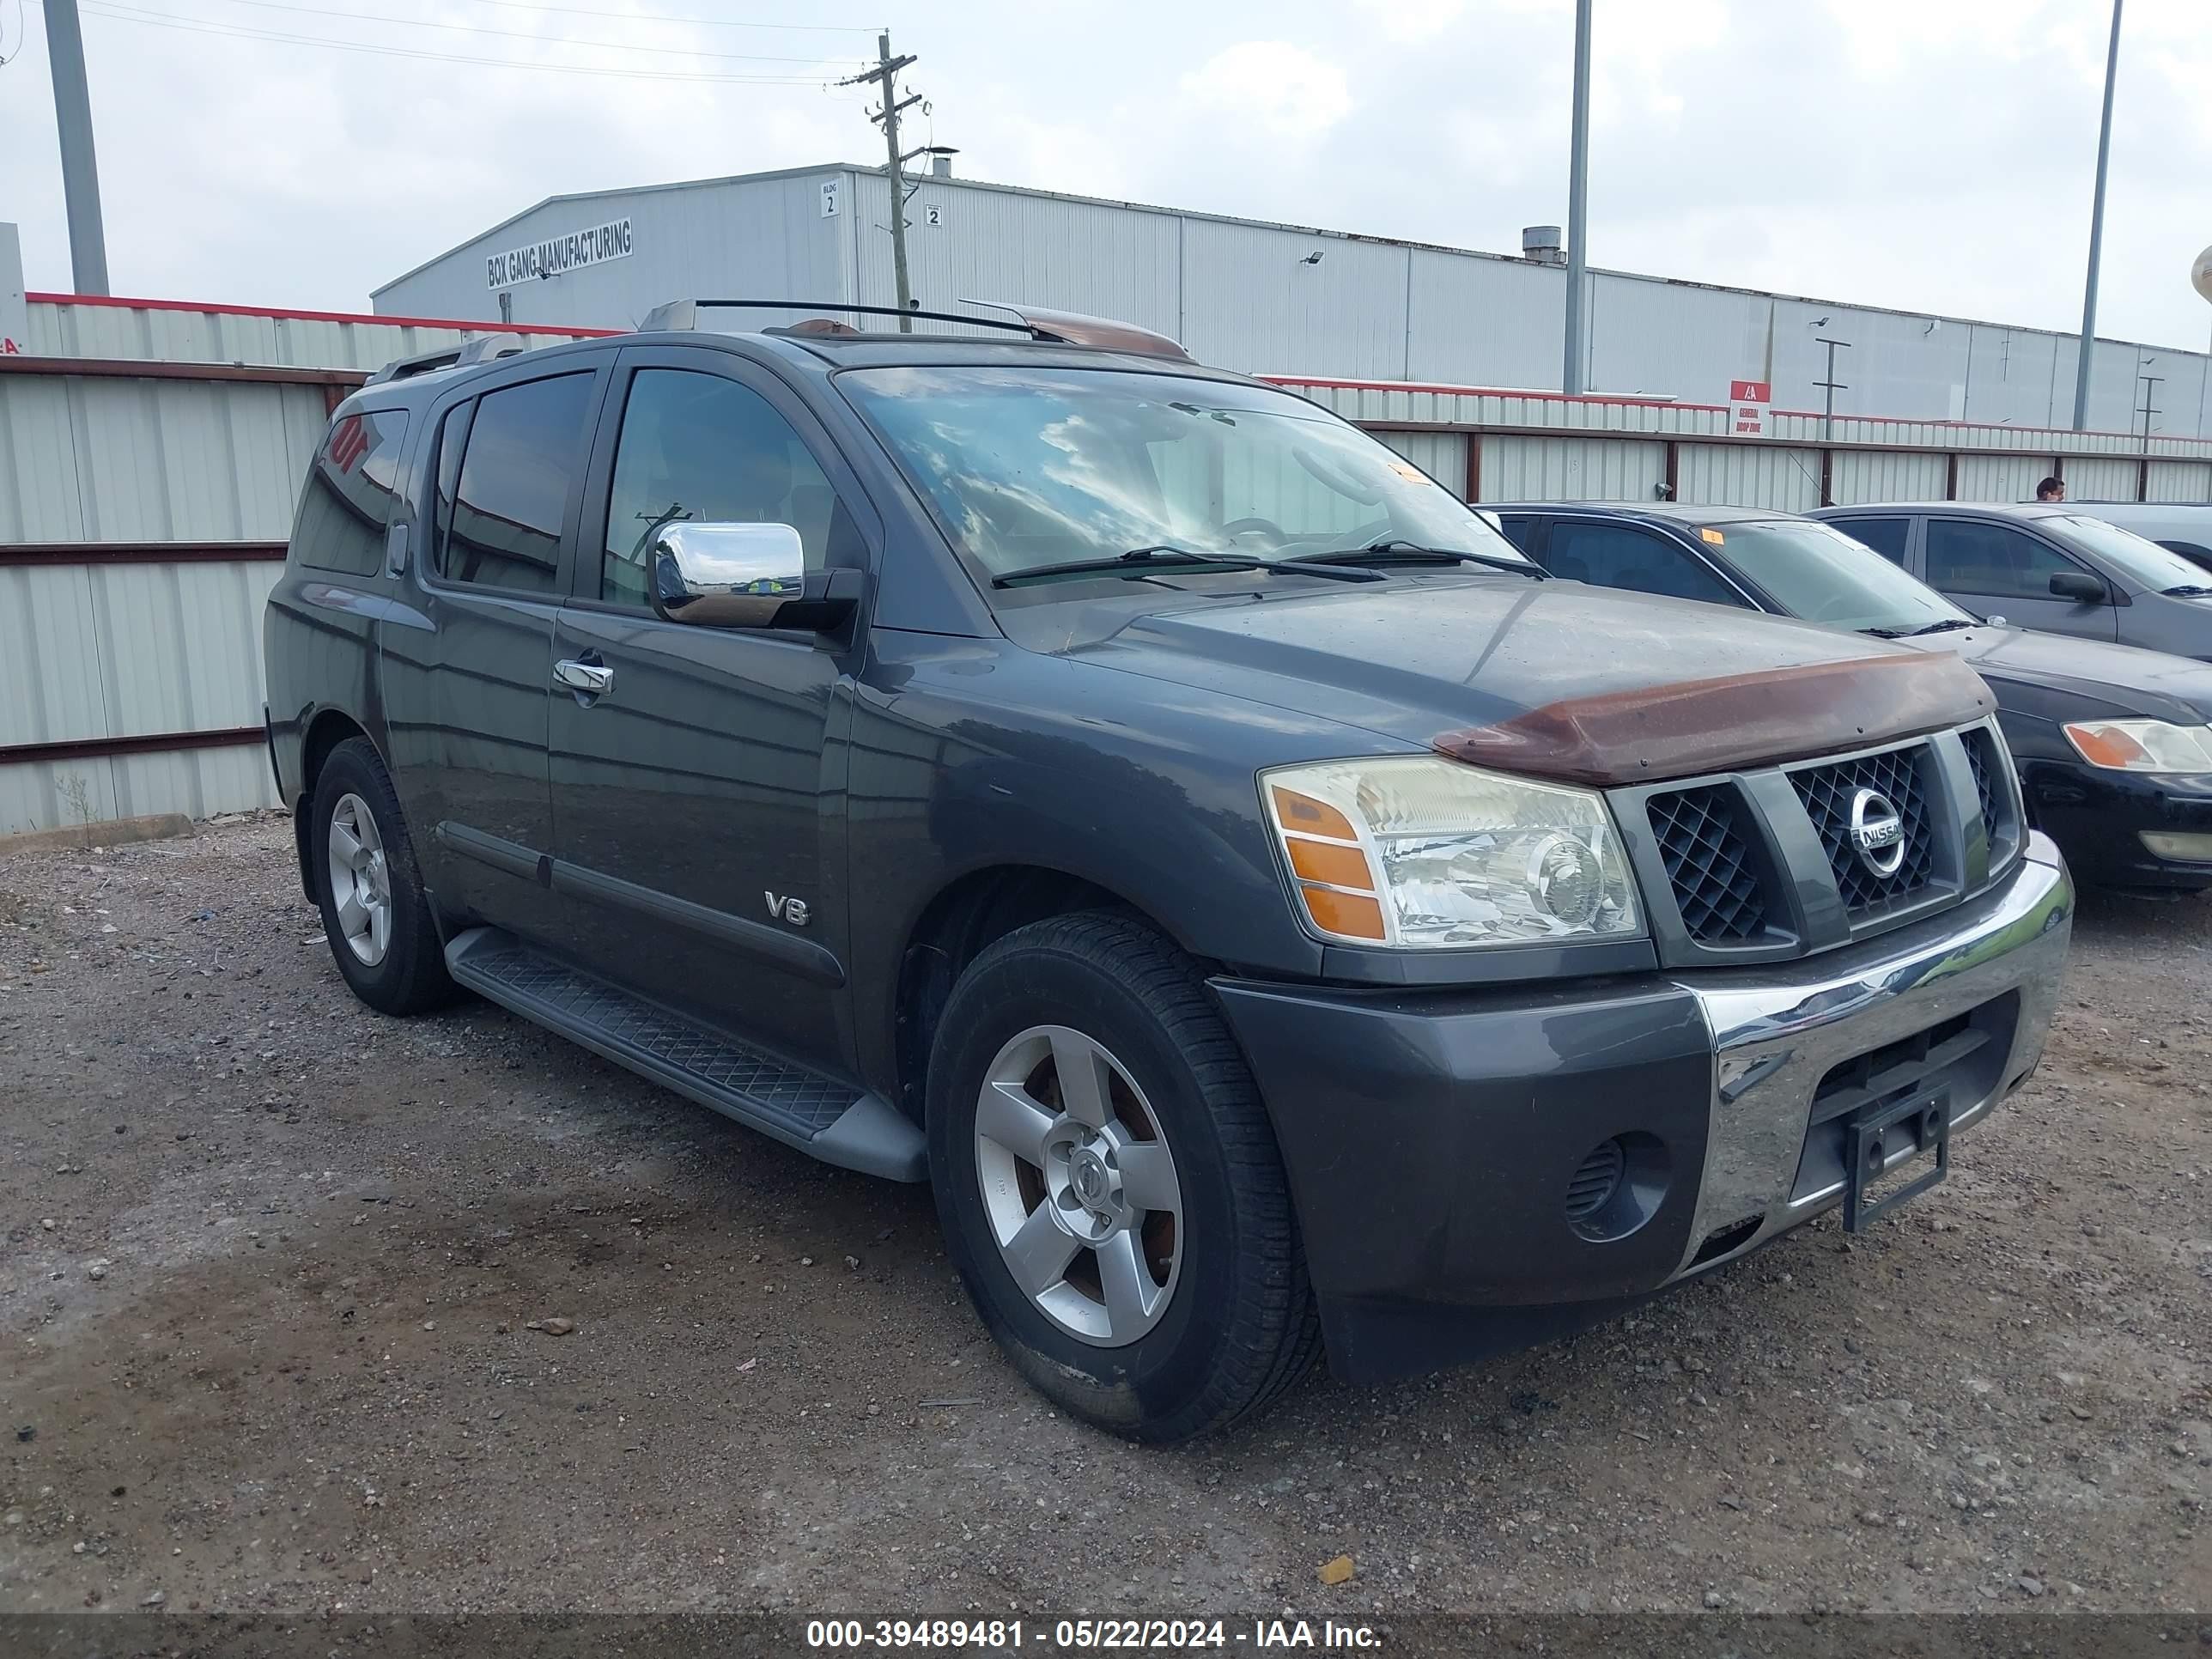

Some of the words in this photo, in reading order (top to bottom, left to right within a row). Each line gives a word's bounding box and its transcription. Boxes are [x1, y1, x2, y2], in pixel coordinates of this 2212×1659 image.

[823, 183, 837, 193] BLDG
[827, 196, 834, 213] 2
[930, 210, 939, 224] 2
[487, 255, 507, 287] BOX
[508, 247, 537, 282] GANG
[538, 220, 632, 273] MANUFACTURING
[763, 890, 807, 927] V8
